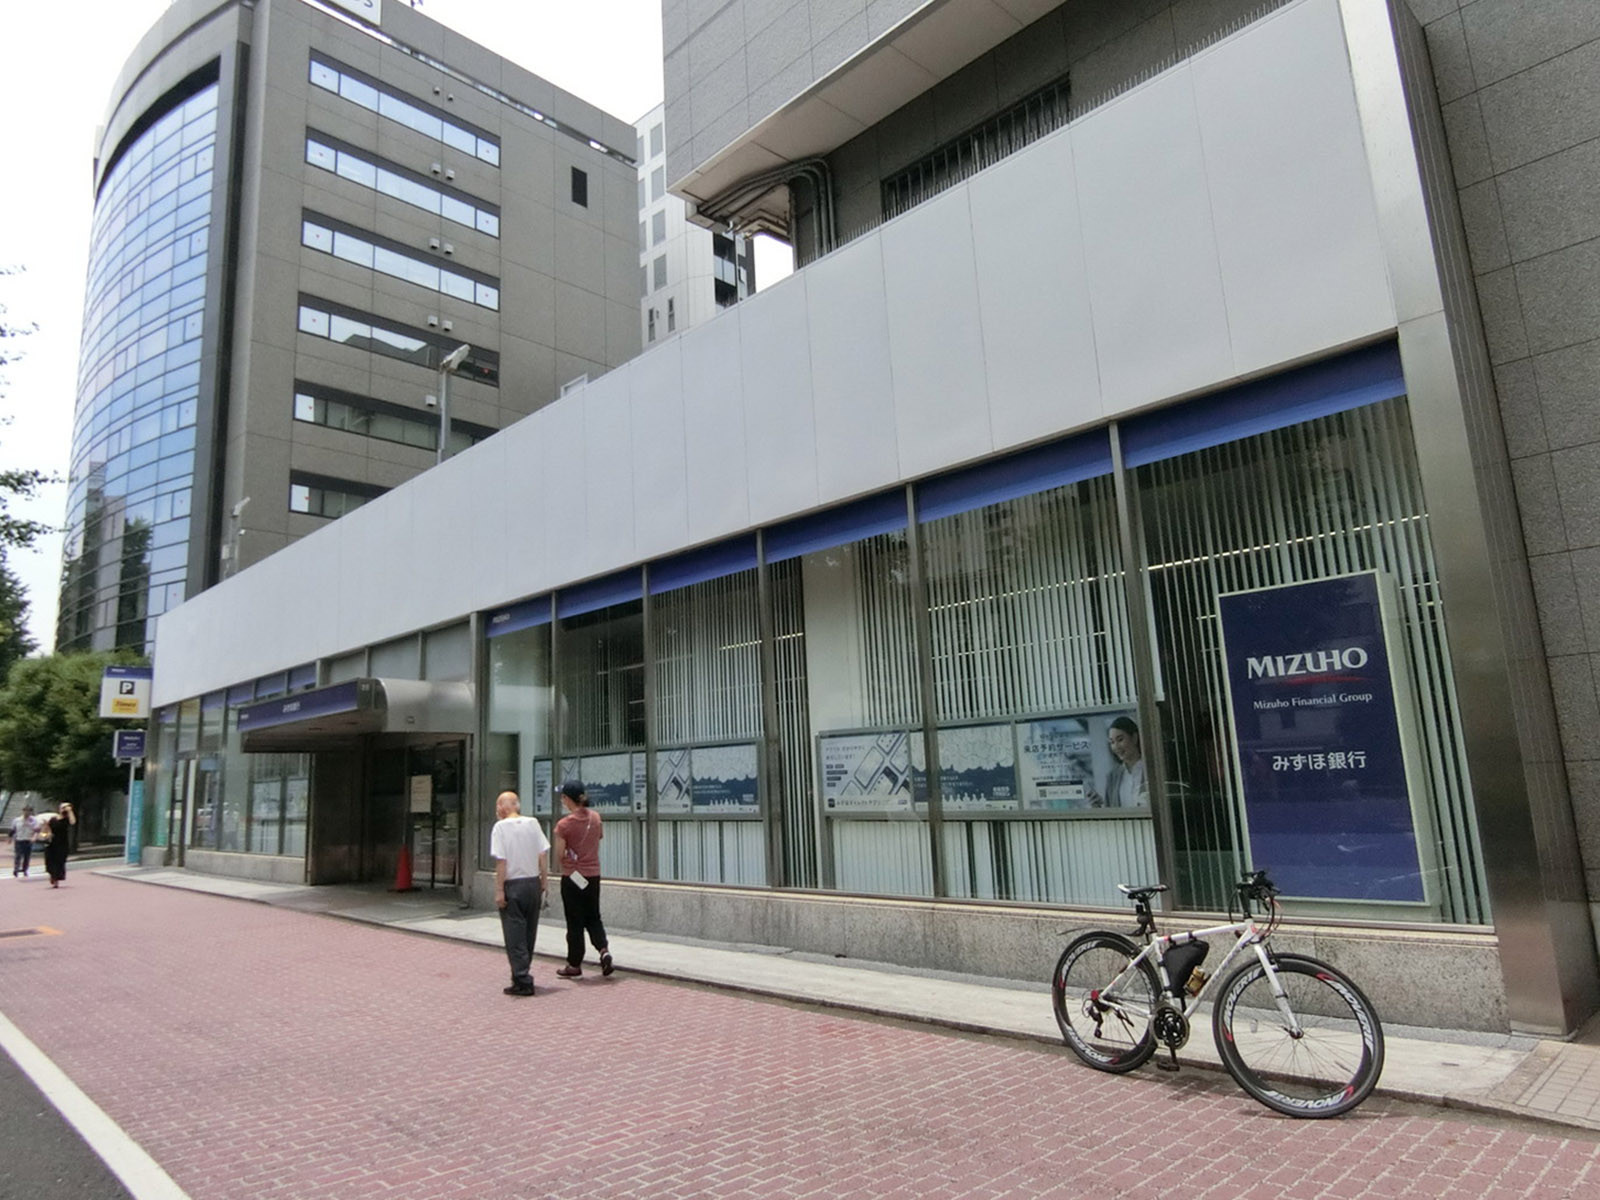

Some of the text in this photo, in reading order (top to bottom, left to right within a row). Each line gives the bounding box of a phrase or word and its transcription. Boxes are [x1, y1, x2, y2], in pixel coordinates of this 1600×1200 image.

[1246, 647, 1368, 679] MIZUHO
[121, 681, 133, 694] P
[1253, 692, 1373, 710] Mizuho Financial Group
[1272, 751, 1366, 771] みずほ銀行
